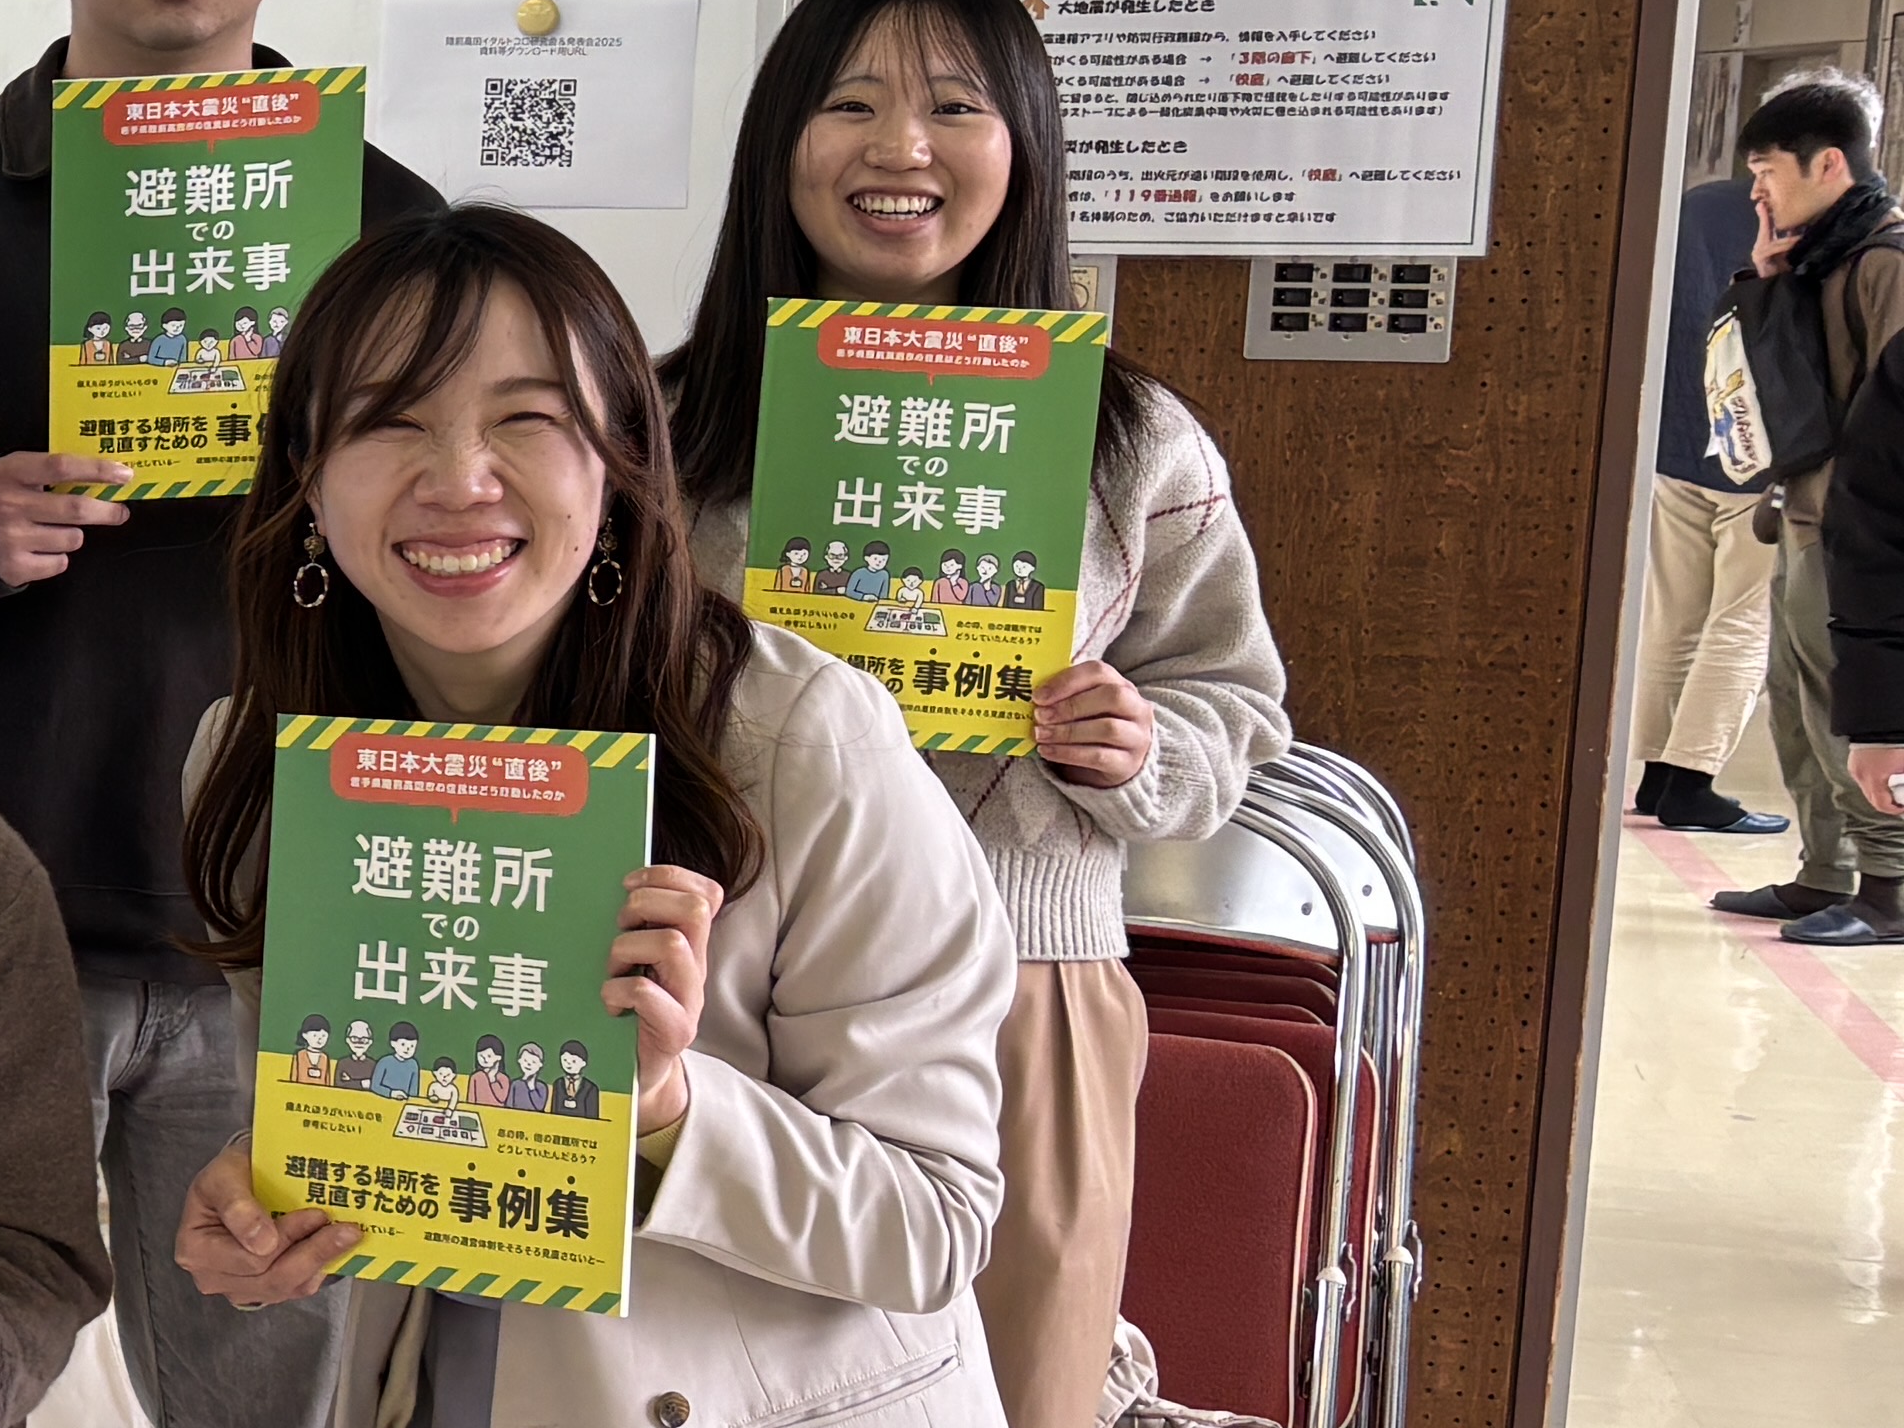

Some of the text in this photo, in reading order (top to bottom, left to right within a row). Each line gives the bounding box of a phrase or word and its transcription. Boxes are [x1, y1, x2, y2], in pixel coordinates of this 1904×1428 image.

[1058, 0, 1215, 15] 大地震が発生したとき
[1049, 54, 1187, 67] がくる可能性がある場合
[126, 93, 299, 121] 東日本大震災“直後”
[124, 159, 294, 217] 避難所
[185, 220, 235, 242] での
[129, 242, 291, 297] 出来事
[843, 326, 1029, 354] 東日本大震災“直後”
[79, 415, 208, 437] 避難する場所を
[834, 394, 1016, 454] 避難所
[98, 433, 208, 454] 見直すための
[896, 455, 949, 478] での
[832, 477, 1007, 535] 出来事
[912, 659, 1033, 703] 事例集
[356, 748, 562, 783] 東日本大震災“直後”
[351, 833, 553, 913] 避難所
[421, 913, 480, 942] での
[354, 940, 549, 1017] 出来事
[284, 1154, 441, 1197] 避難する場所を
[305, 1181, 439, 1220] 見直すための
[448, 1176, 589, 1240] 事例集
